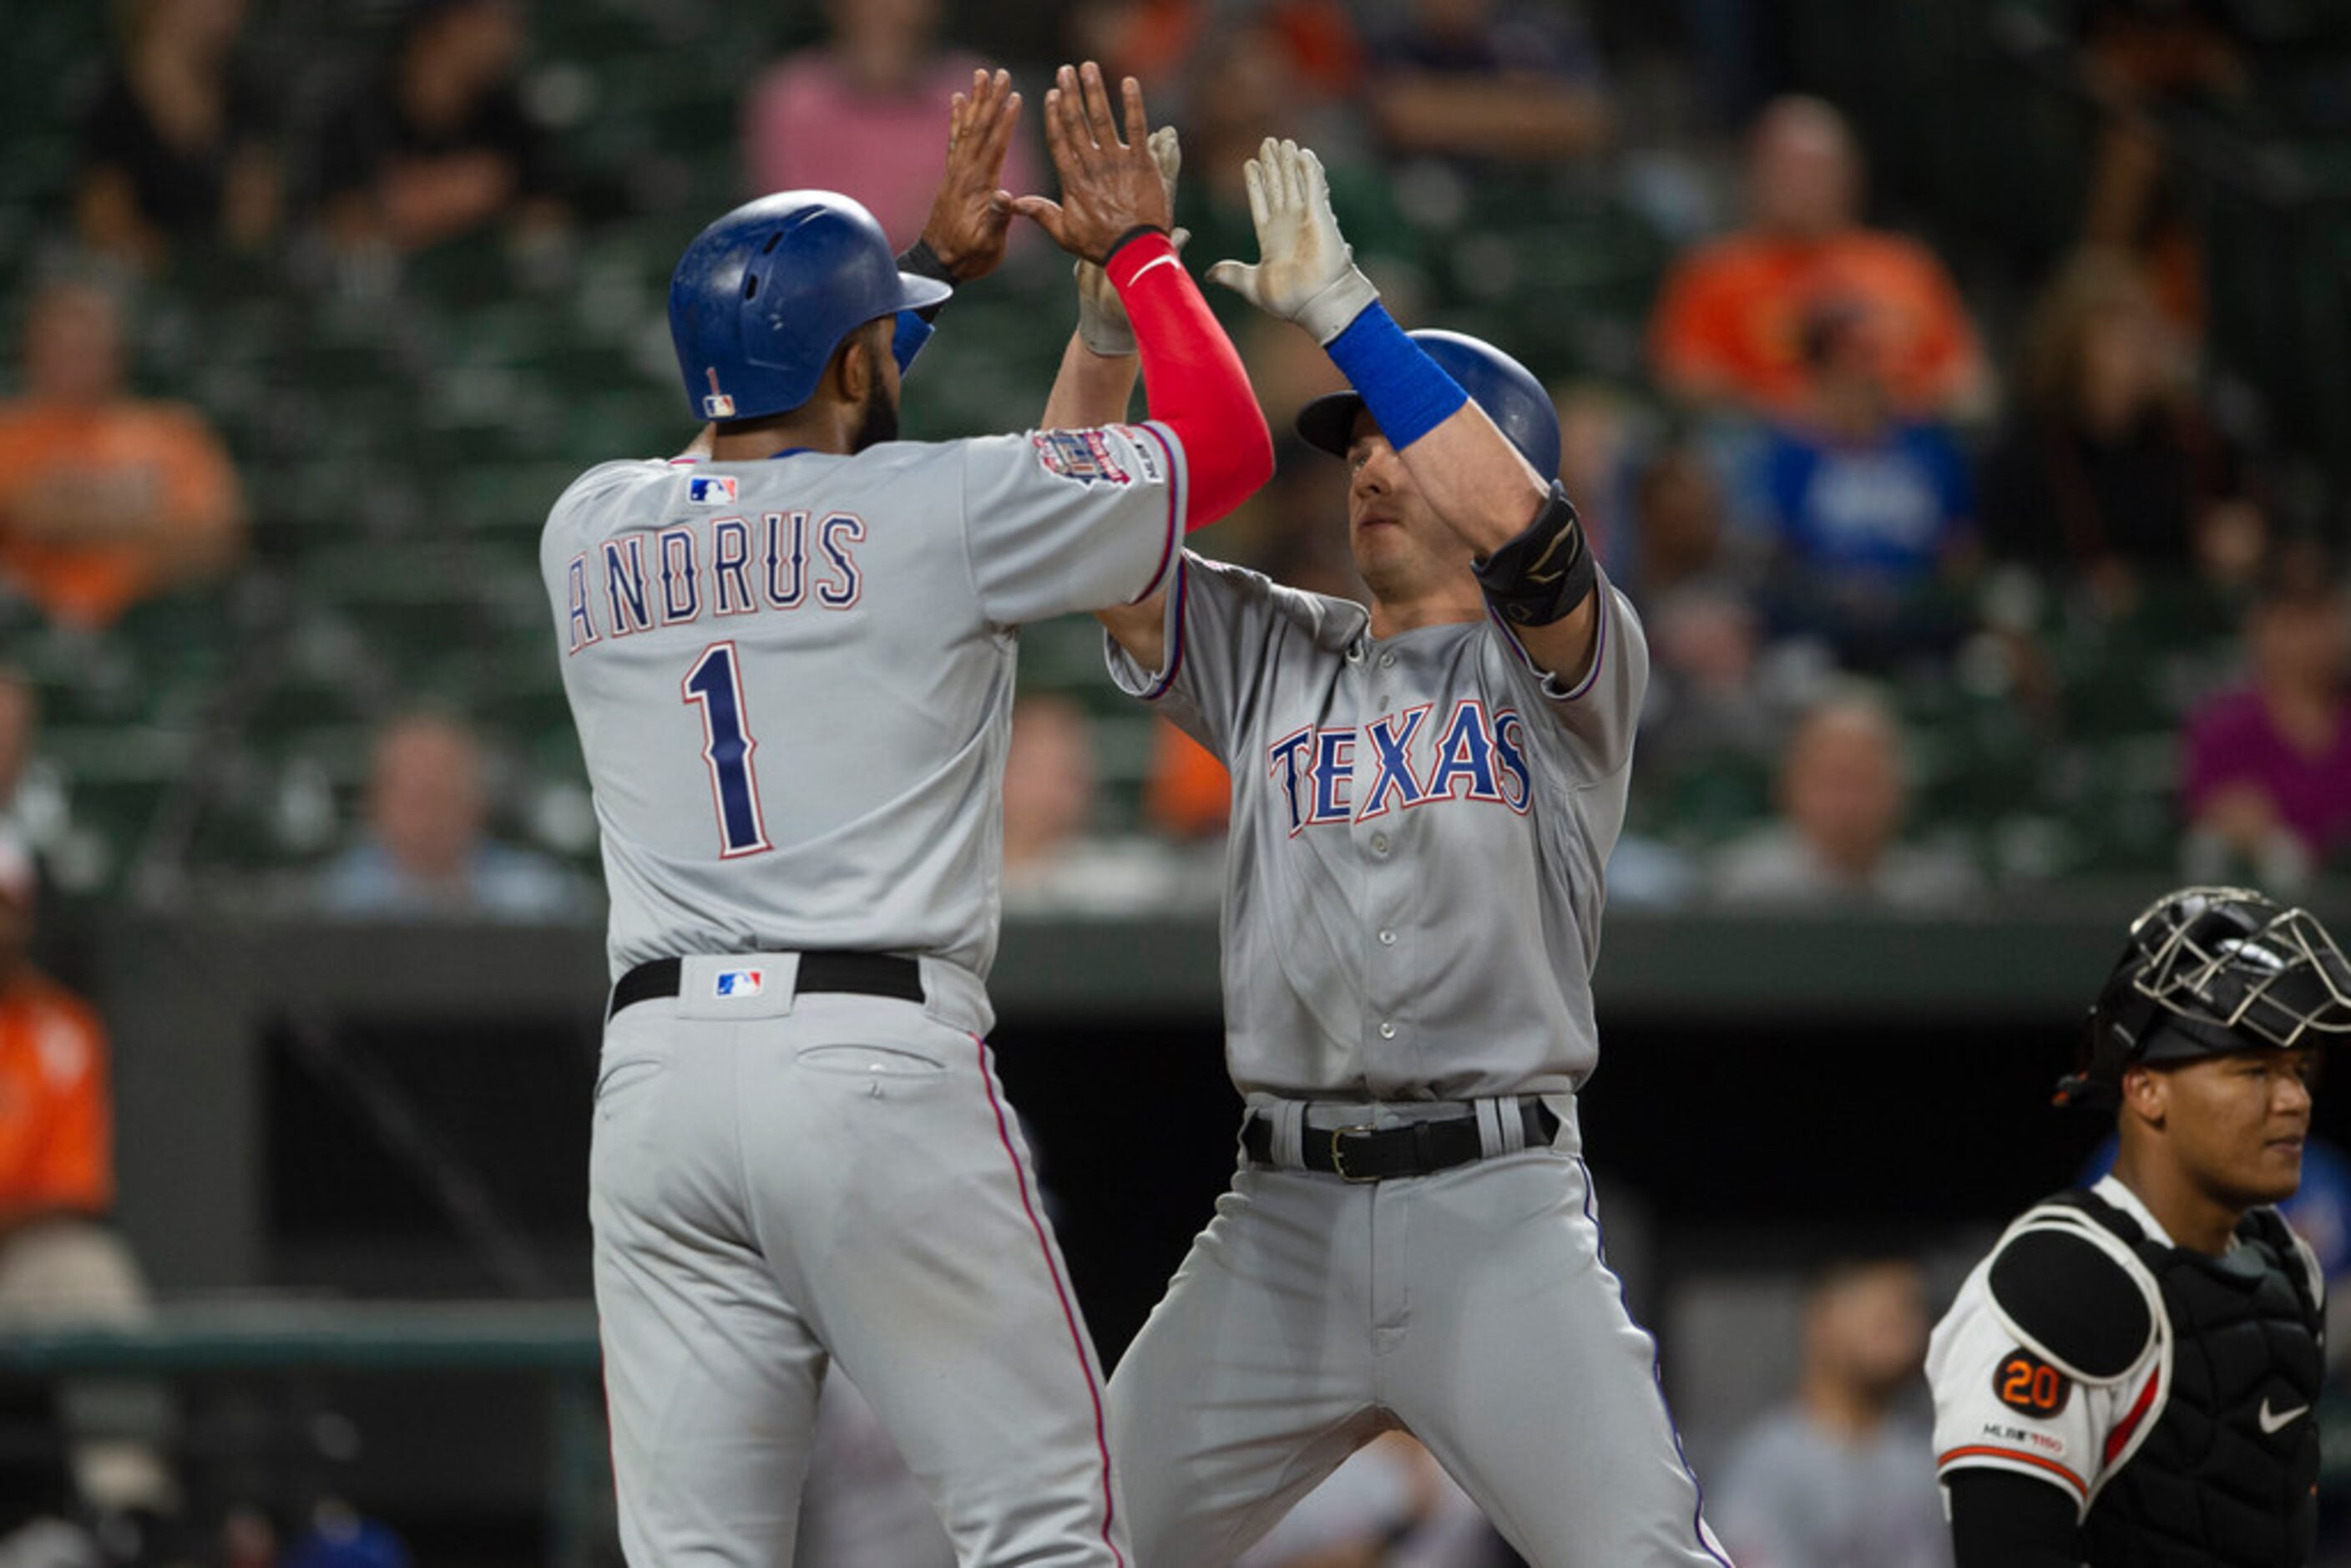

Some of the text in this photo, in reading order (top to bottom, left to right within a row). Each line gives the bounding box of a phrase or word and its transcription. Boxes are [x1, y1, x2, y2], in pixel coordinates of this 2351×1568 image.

[569, 511, 866, 656] ANDRUS
[682, 640, 773, 859] 1
[1269, 700, 1533, 838] TEXAS
[2004, 1358, 2059, 1409] 20
